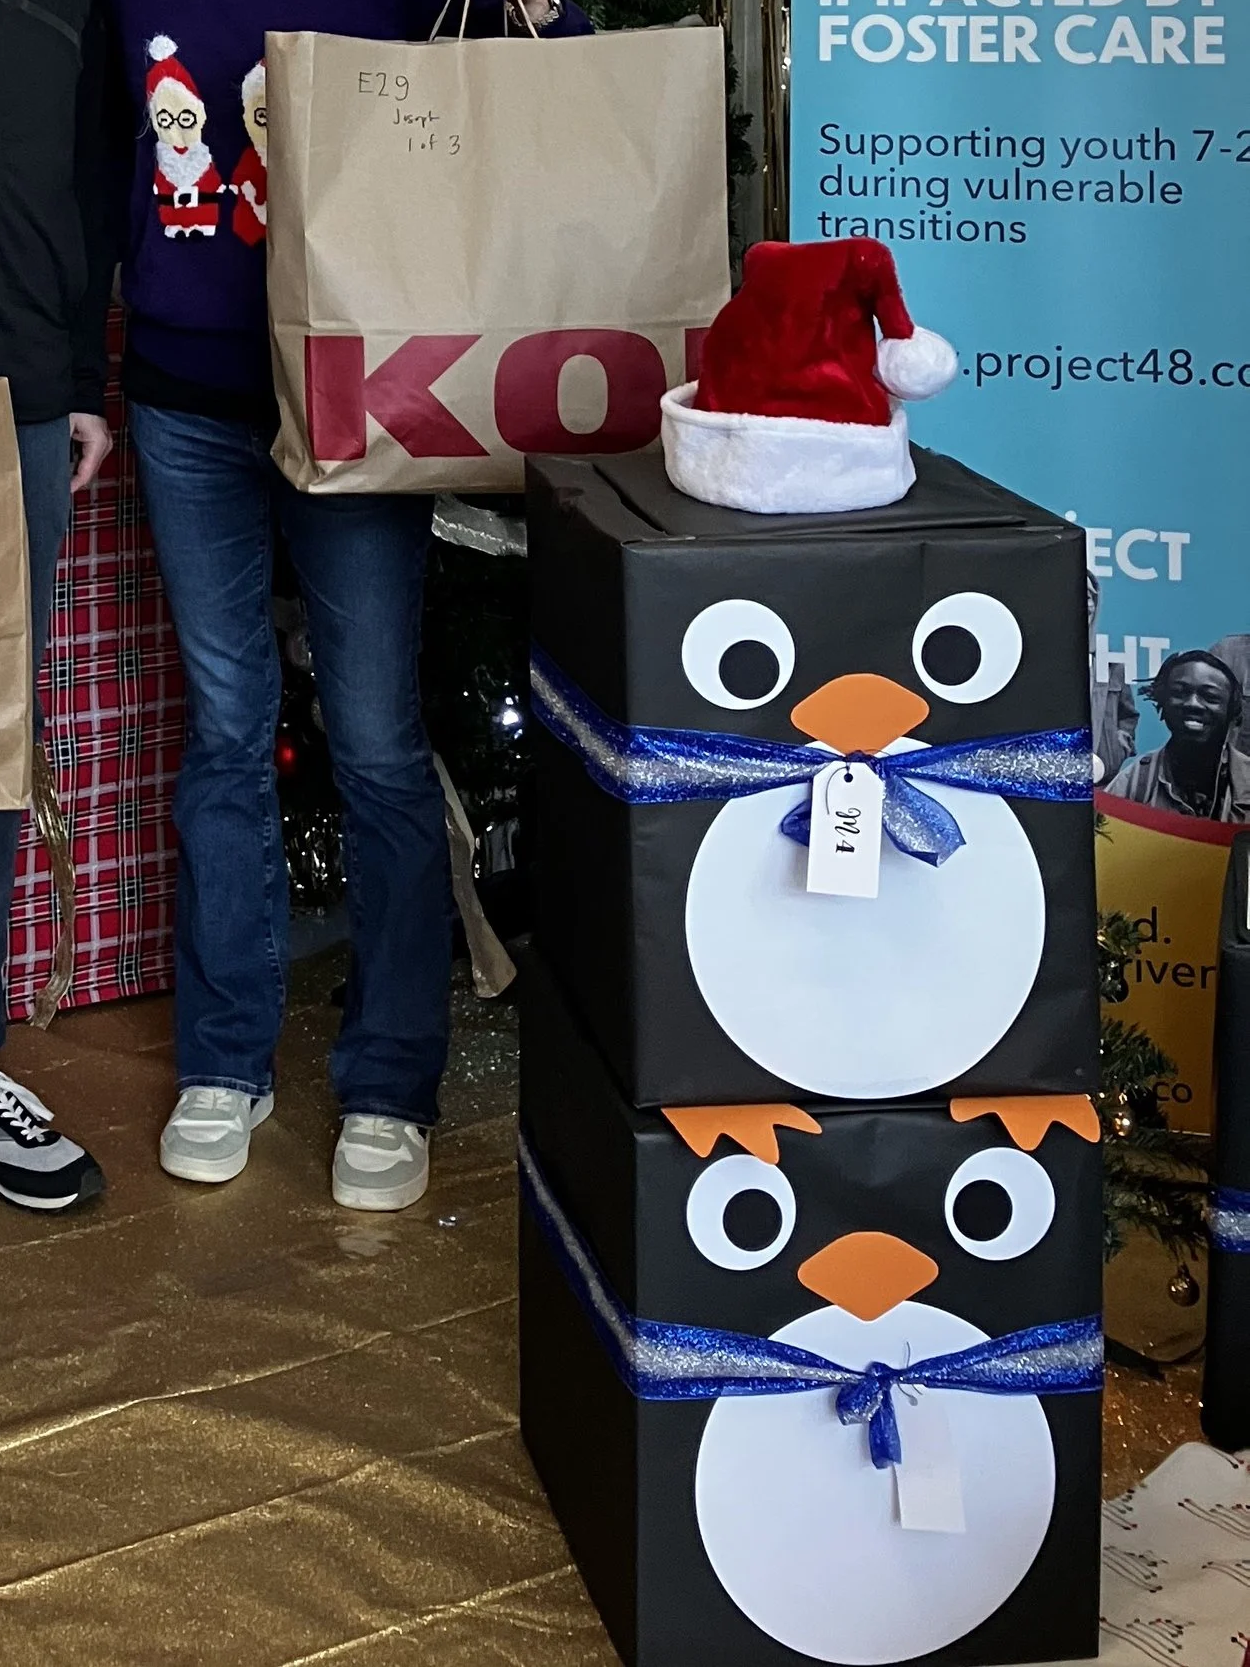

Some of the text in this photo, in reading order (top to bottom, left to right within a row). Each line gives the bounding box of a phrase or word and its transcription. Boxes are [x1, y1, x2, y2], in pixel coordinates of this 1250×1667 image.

[818, 13, 1226, 65] FOSTER CARE
[358, 71, 410, 102] E29
[420, 133, 438, 151] of
[448, 134, 461, 156] 3
[819, 123, 1045, 168] Supporting
[1060, 127, 1176, 168] youth
[818, 164, 1183, 208] during vulnerable
[817, 210, 1027, 243] transitions
[956, 345, 1250, 390] .project48.co
[304, 327, 711, 461] KO
[1085, 527, 1191, 581] ECT
